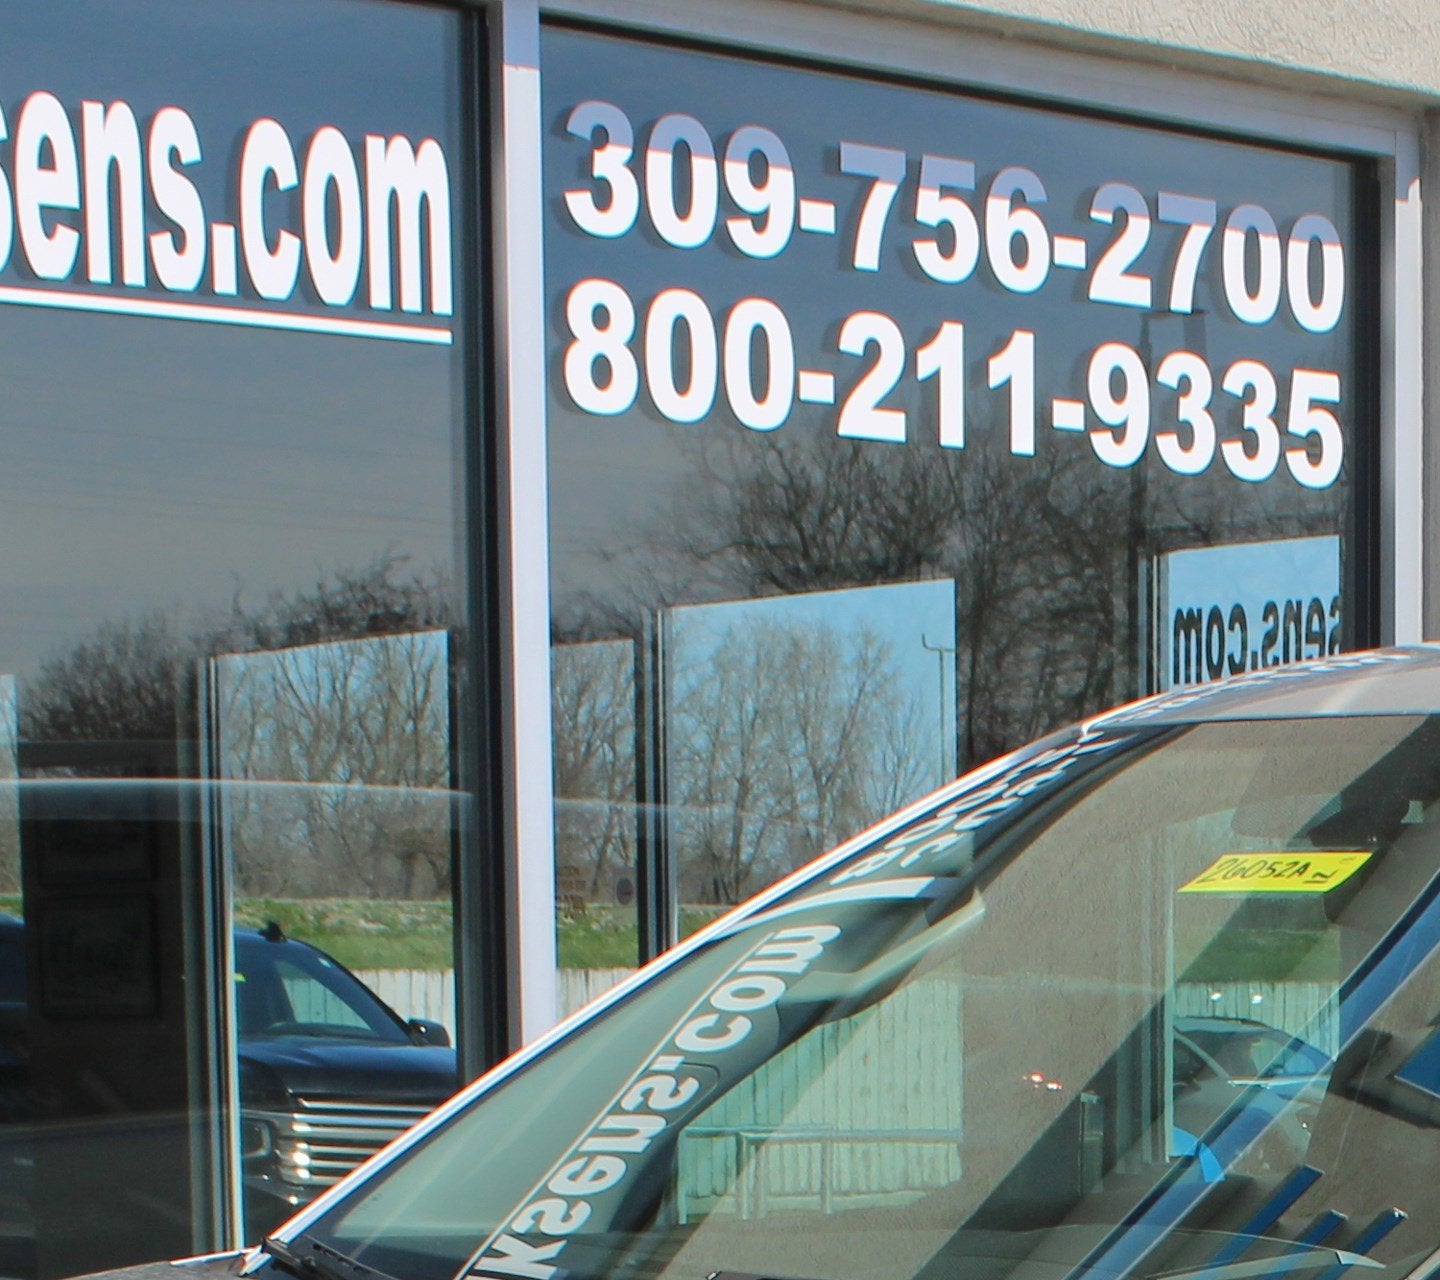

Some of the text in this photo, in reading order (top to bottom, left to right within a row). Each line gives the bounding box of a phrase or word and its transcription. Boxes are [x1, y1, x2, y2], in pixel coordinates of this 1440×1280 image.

[564, 100, 1345, 334] 309-756-2700
[564, 279, 1345, 490] 800-211-9335
[1195, 857, 1312, 884] 26052A
